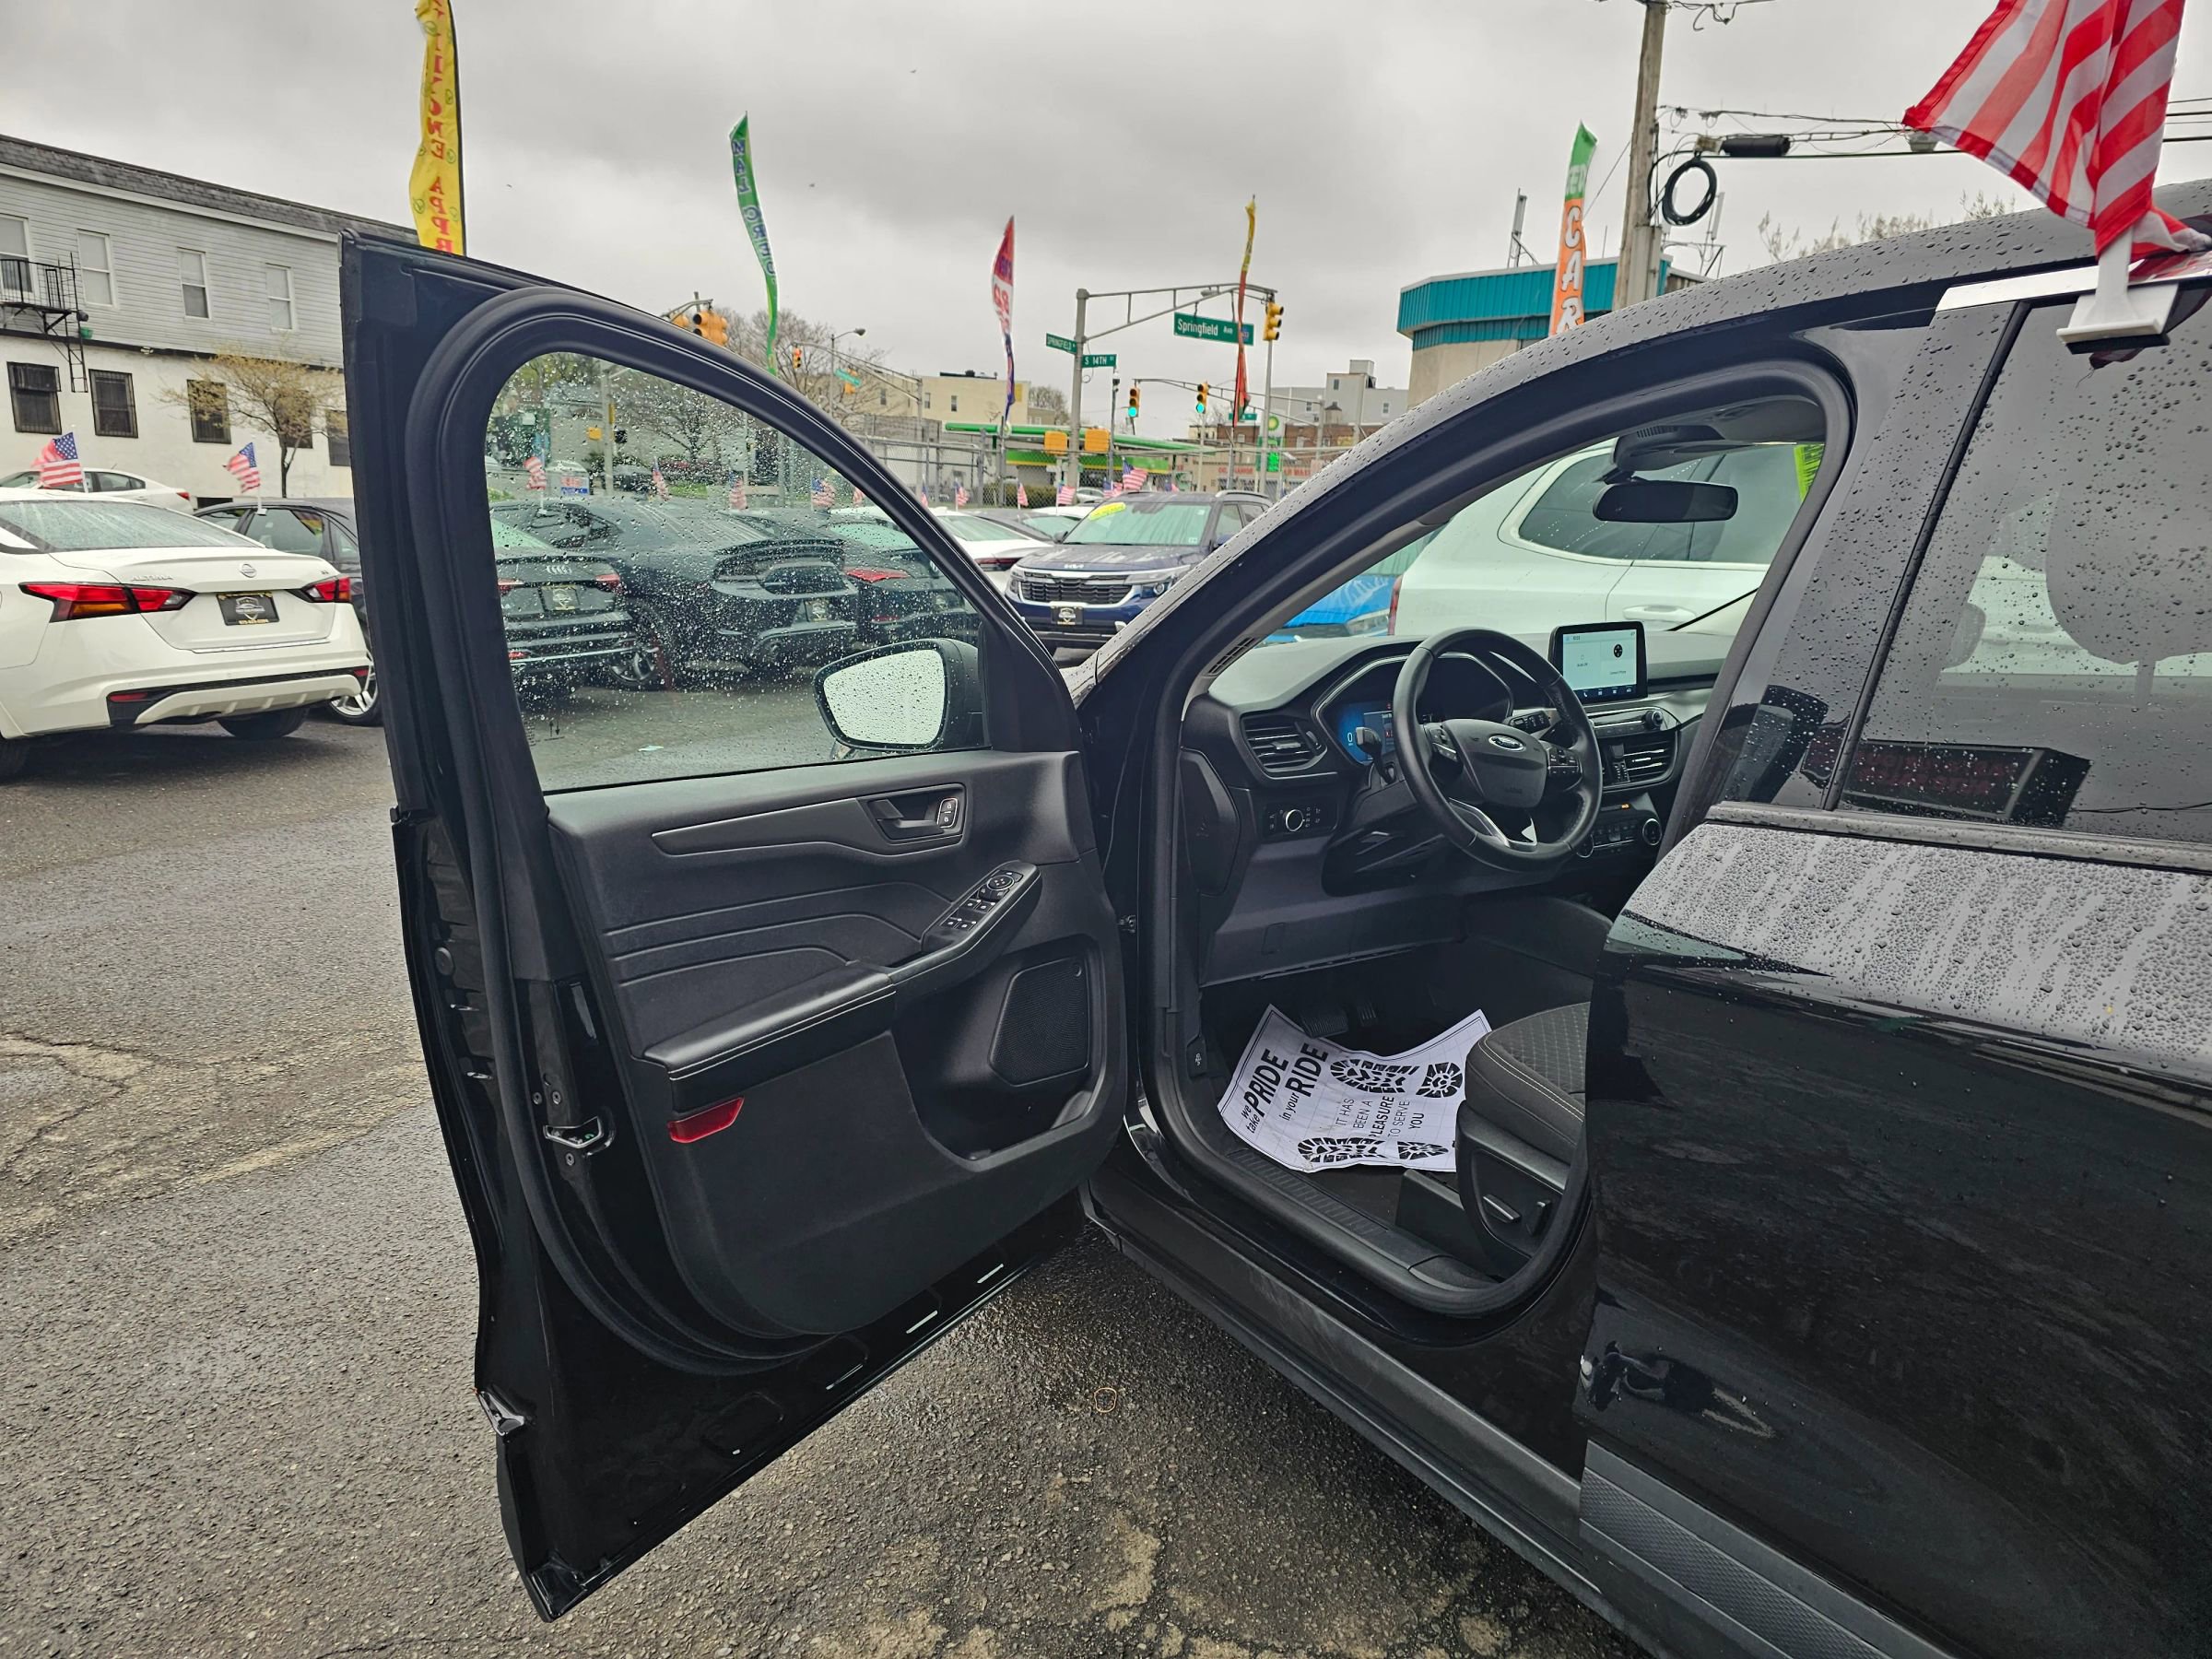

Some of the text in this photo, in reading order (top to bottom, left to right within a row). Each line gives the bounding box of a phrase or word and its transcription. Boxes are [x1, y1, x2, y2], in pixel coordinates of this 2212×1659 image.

[1177, 318, 1219, 337] Springfield
[1084, 356, 1089, 366] S
[1092, 356, 1107, 366] 14TH
[1347, 732, 1353, 743] 0
[1243, 1048, 1289, 1134] take PRIDE
[1278, 1041, 1329, 1122] in your RIDE
[1241, 1105, 1252, 1119] we
[1335, 1098, 1355, 1126] IT HAS
[1352, 1108, 1371, 1129] BEEN
[1368, 1095, 1395, 1138] PLEASURE
[1387, 1100, 1410, 1137] TO SERVE
[1408, 1112, 1425, 1130] YOU
